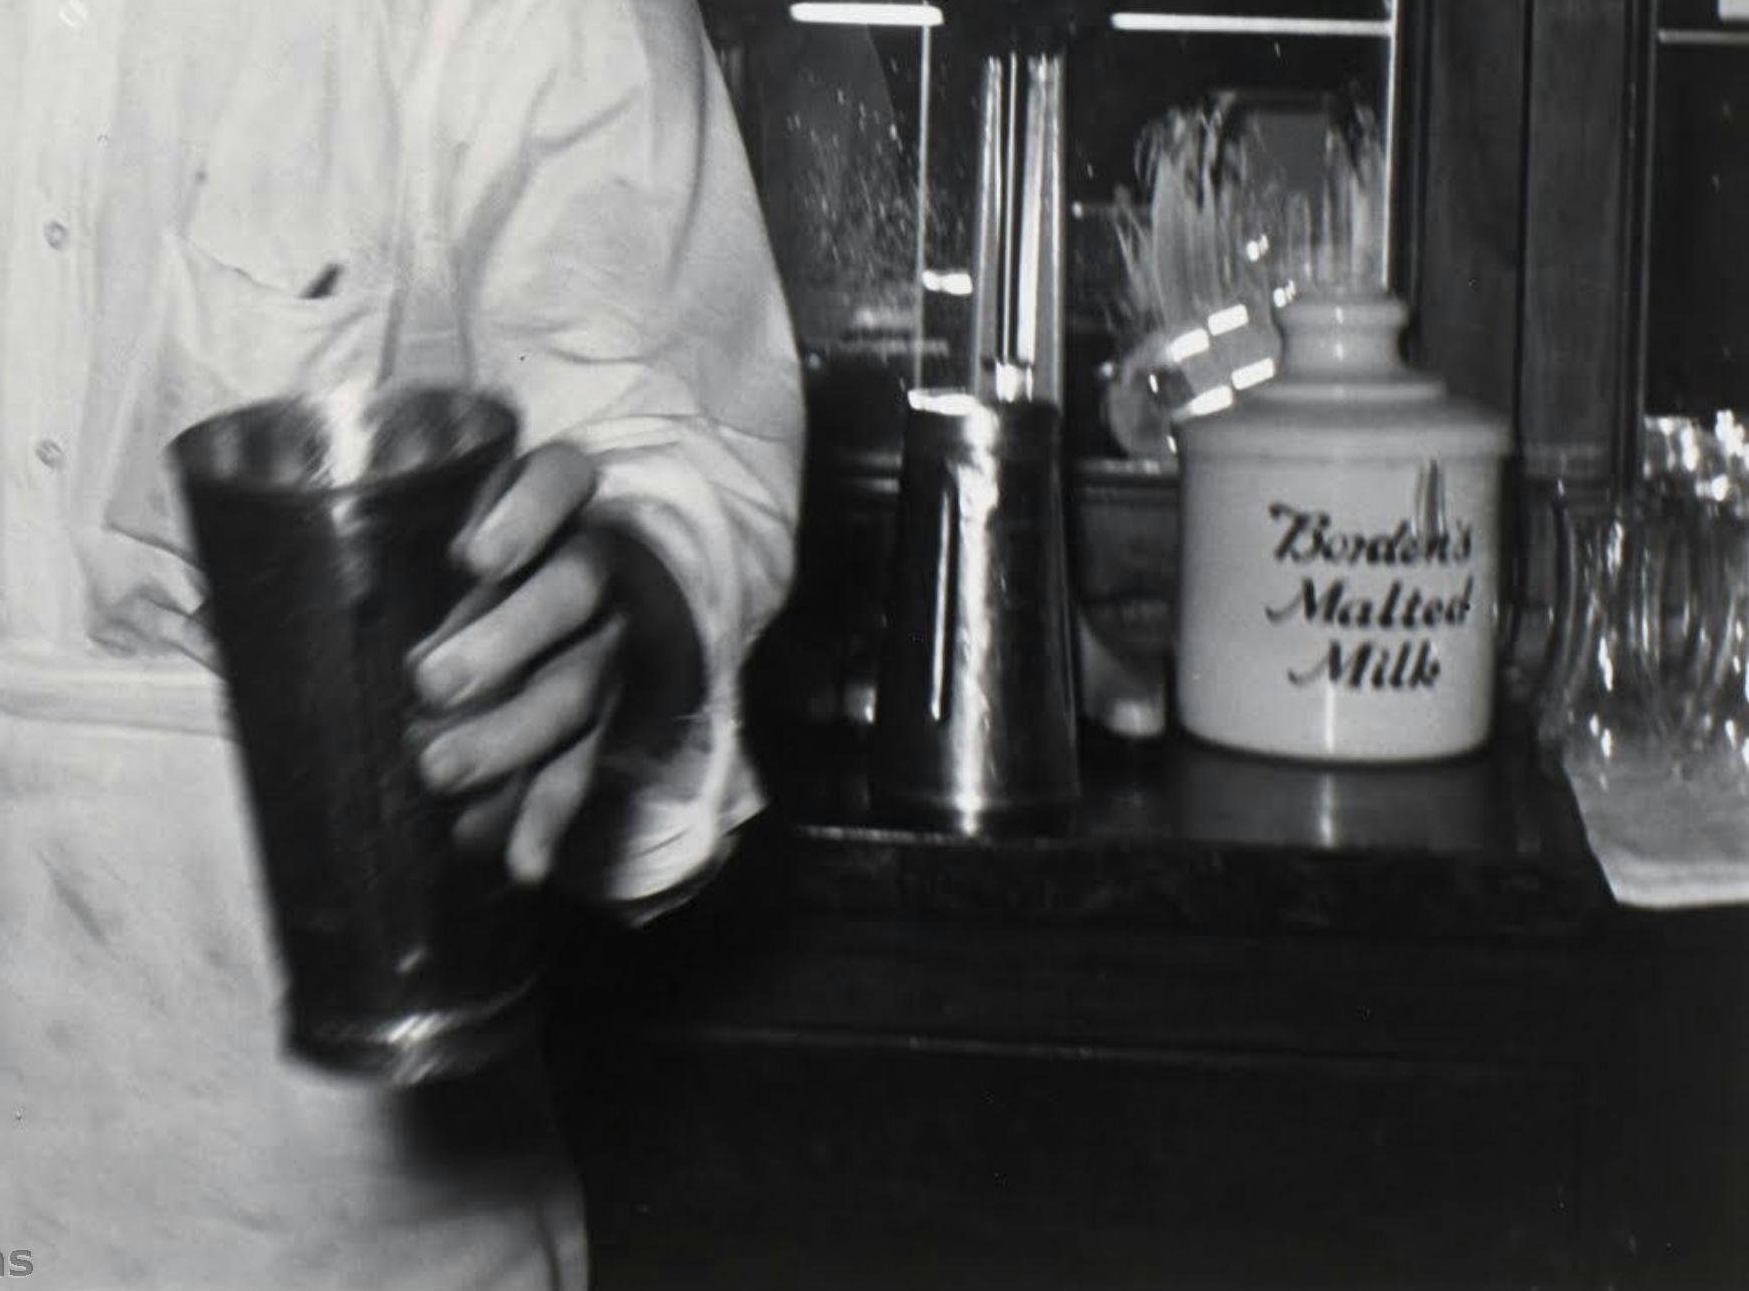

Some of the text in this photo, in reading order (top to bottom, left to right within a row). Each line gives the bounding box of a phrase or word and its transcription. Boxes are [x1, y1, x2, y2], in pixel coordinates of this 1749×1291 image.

[1267, 501, 1473, 567] Borden's
[1264, 575, 1475, 630] Malted
[1287, 639, 1442, 691] Milk
